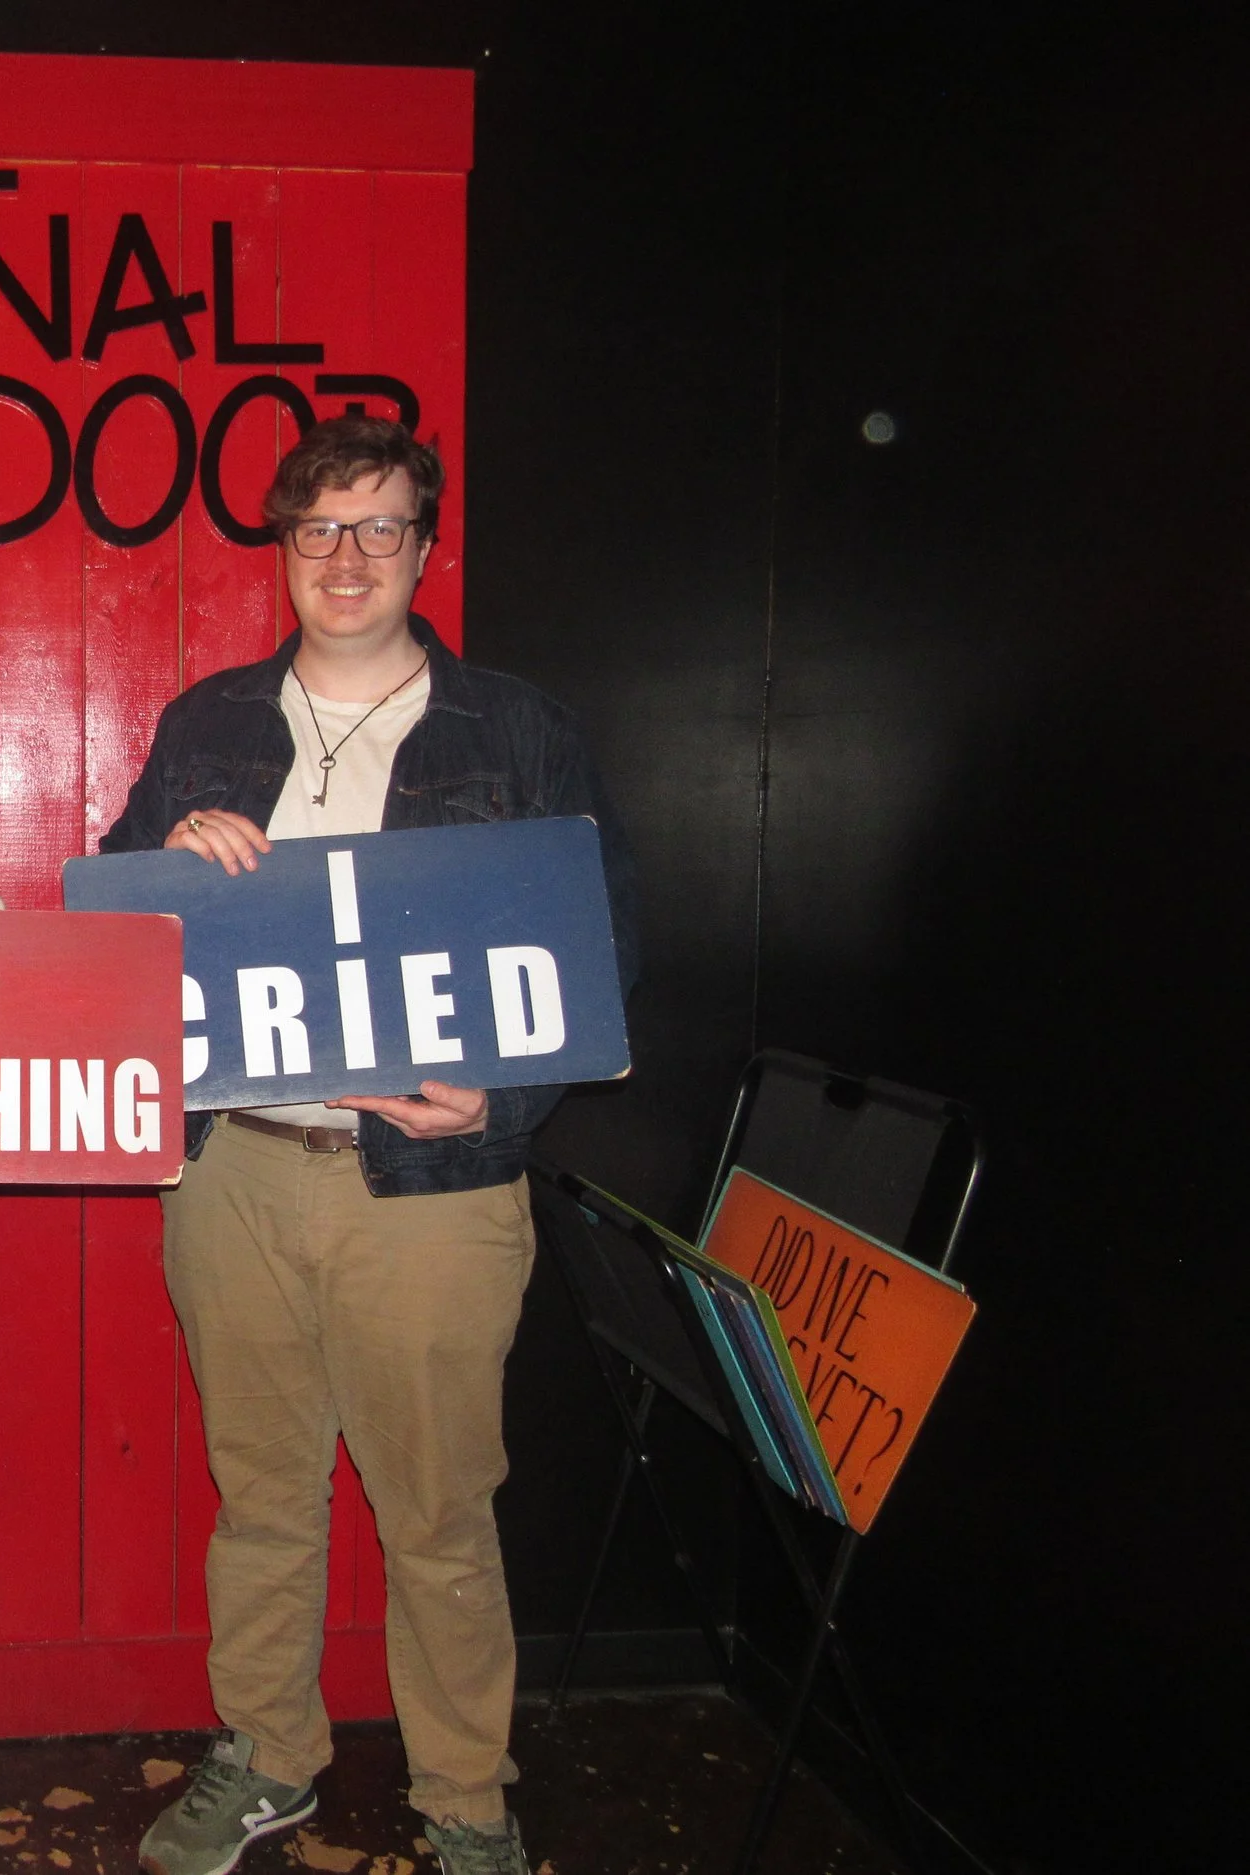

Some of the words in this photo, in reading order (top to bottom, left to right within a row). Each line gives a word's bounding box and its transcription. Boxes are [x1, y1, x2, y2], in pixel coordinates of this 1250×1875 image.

[326, 850, 362, 946] I
[751, 1215, 814, 1311] DID
[803, 1245, 890, 1363] WE
